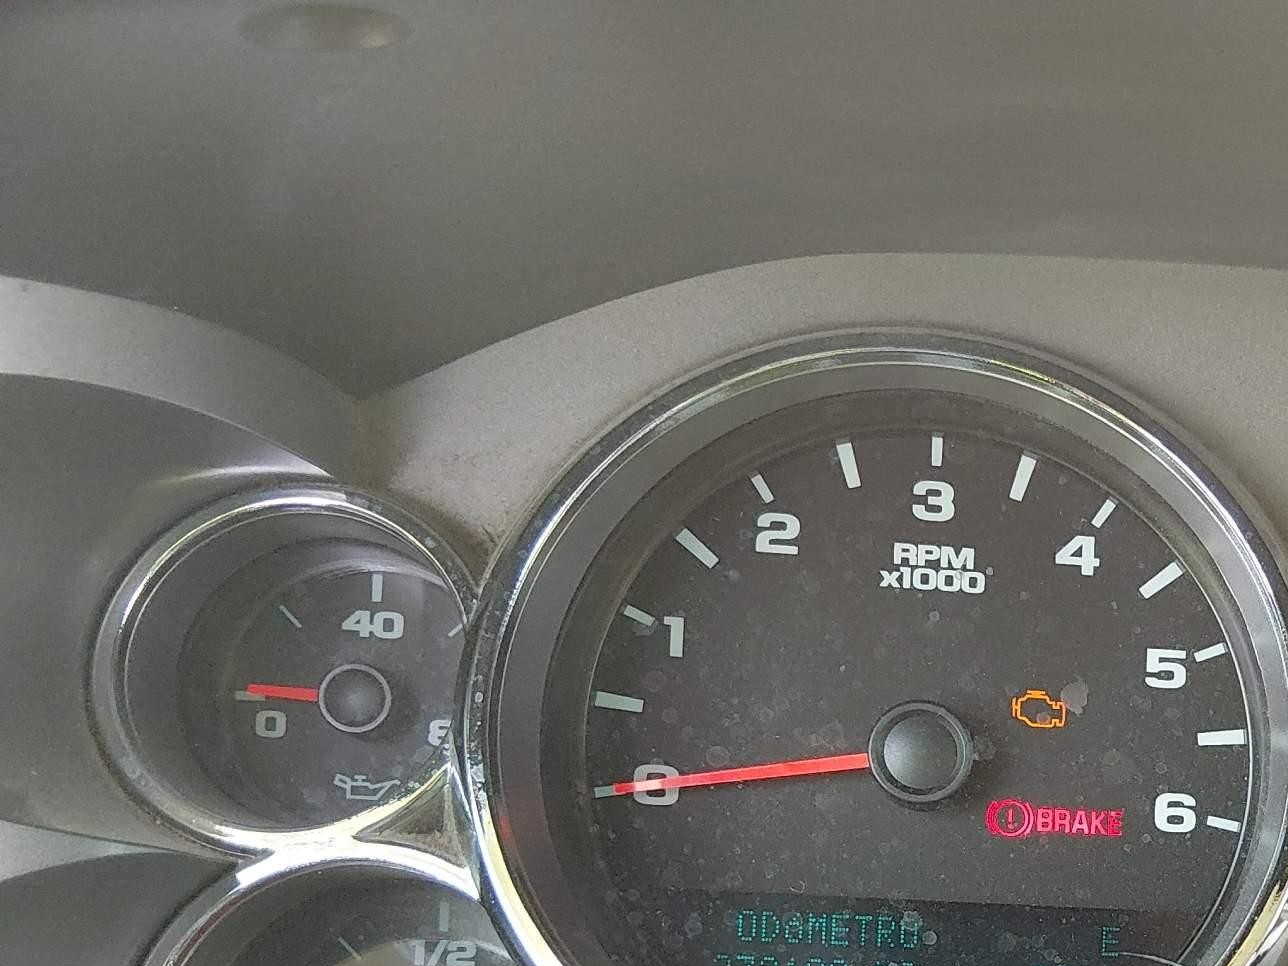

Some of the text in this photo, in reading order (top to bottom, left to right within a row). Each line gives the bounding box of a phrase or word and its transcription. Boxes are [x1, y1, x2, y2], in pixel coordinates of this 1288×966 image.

[912, 480, 956, 522] 3
[755, 512, 800, 555] 2
[893, 542, 975, 570] RPM
[1055, 535, 1101, 577] 4
[880, 566, 986, 594] x1000
[341, 610, 405, 640] 40
[663, 615, 684, 658] 1
[1144, 647, 1187, 688] 5
[254, 709, 287, 739] 0
[1036, 808, 1123, 836] BRAKE
[1154, 792, 1197, 833] 6
